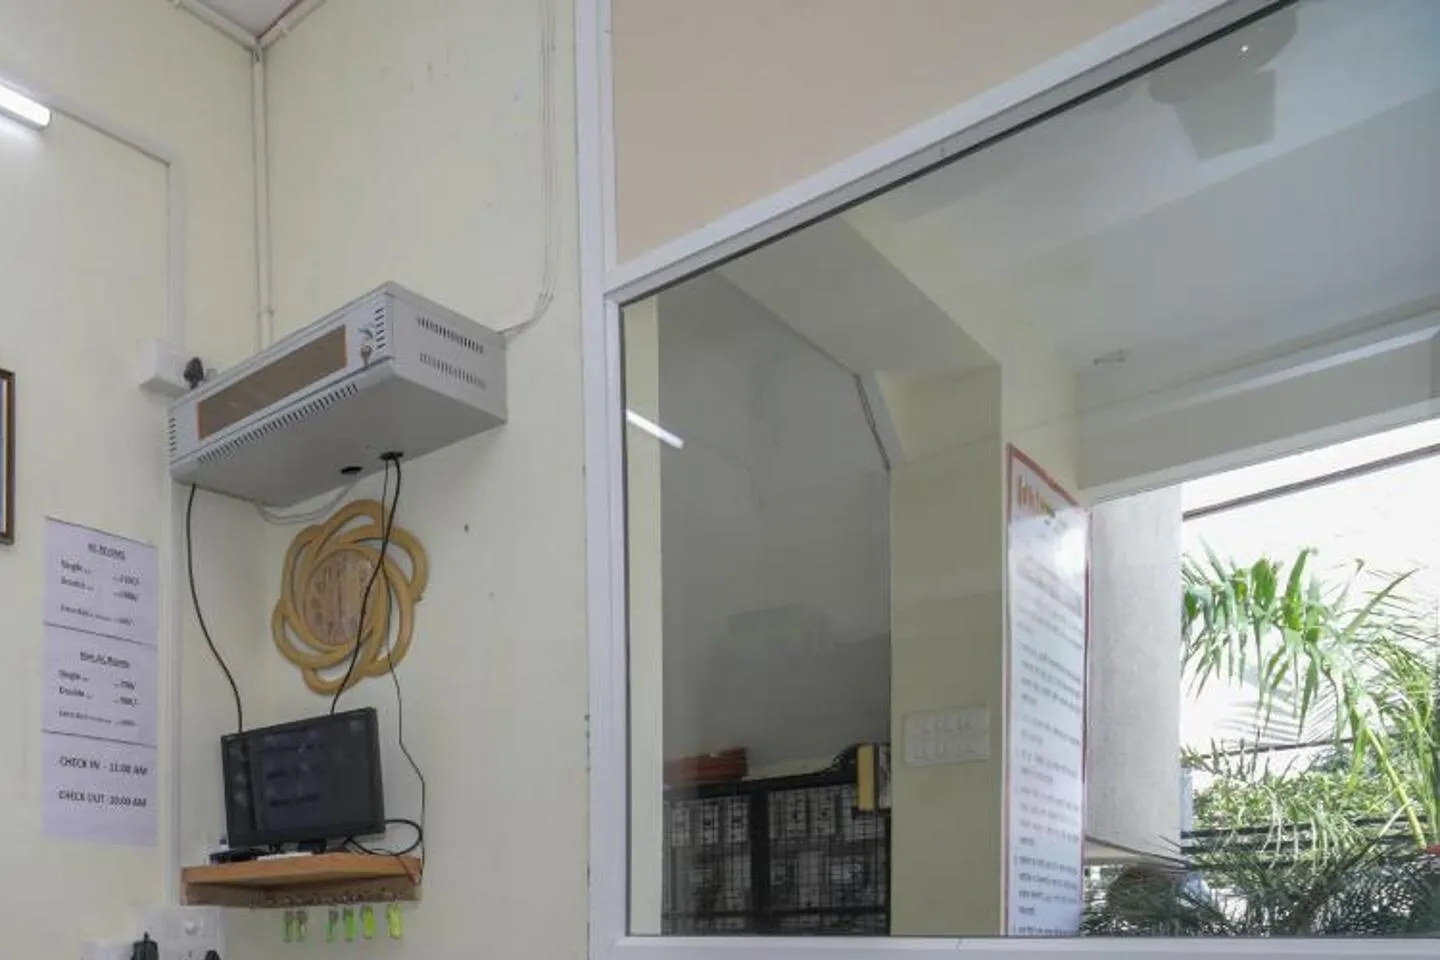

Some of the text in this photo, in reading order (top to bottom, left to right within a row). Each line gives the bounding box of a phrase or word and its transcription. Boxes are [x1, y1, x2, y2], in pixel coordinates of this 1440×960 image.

[59, 756, 87, 769] CHECK
[89, 759, 101, 770] IN
[58, 789, 86, 802] CHECK
[88, 792, 105, 804] OUT
